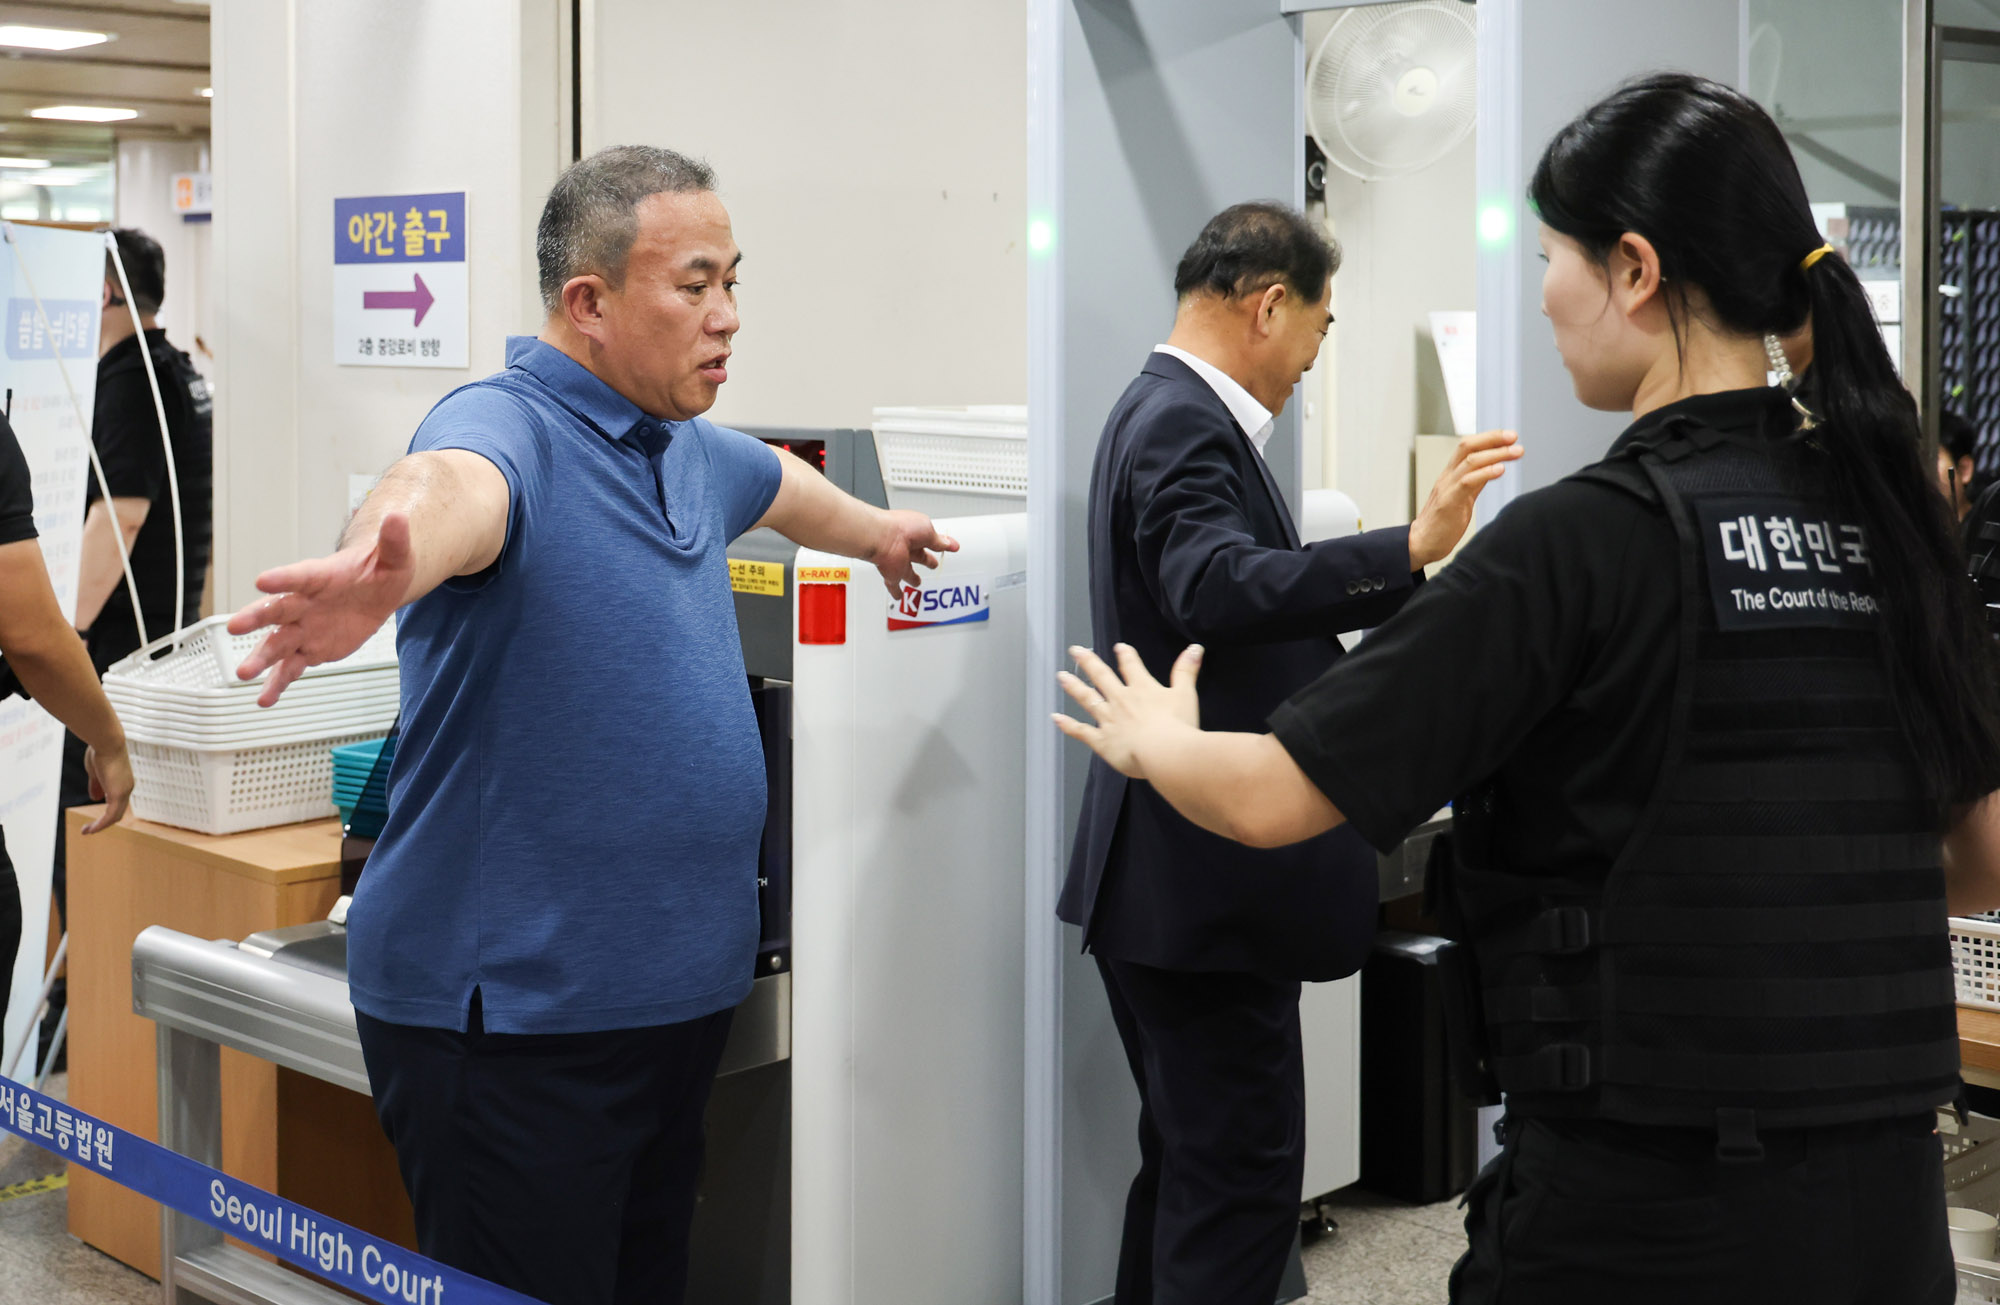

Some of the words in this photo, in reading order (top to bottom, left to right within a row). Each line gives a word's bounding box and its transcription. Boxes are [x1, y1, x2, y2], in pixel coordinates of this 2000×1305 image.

[348, 211, 397, 256] 야간
[402, 207, 451, 256] 출구
[358, 337, 373, 356] 2층
[378, 338, 416, 356] 중앙로비
[420, 338, 440, 357] 방향
[1719, 515, 1874, 577] 대한민국
[749, 564, 766, 577] 주의
[800, 569, 831, 579] X-RAY
[834, 570, 848, 579] ON
[1730, 588, 1766, 611] The
[1768, 587, 1817, 610] Court
[1817, 588, 1828, 608] of
[1829, 590, 1849, 611] the
[0, 1085, 114, 1171] 서울고등법원
[210, 1179, 283, 1244] Seoul
[290, 1212, 354, 1275] High
[361, 1244, 444, 1305] Court
